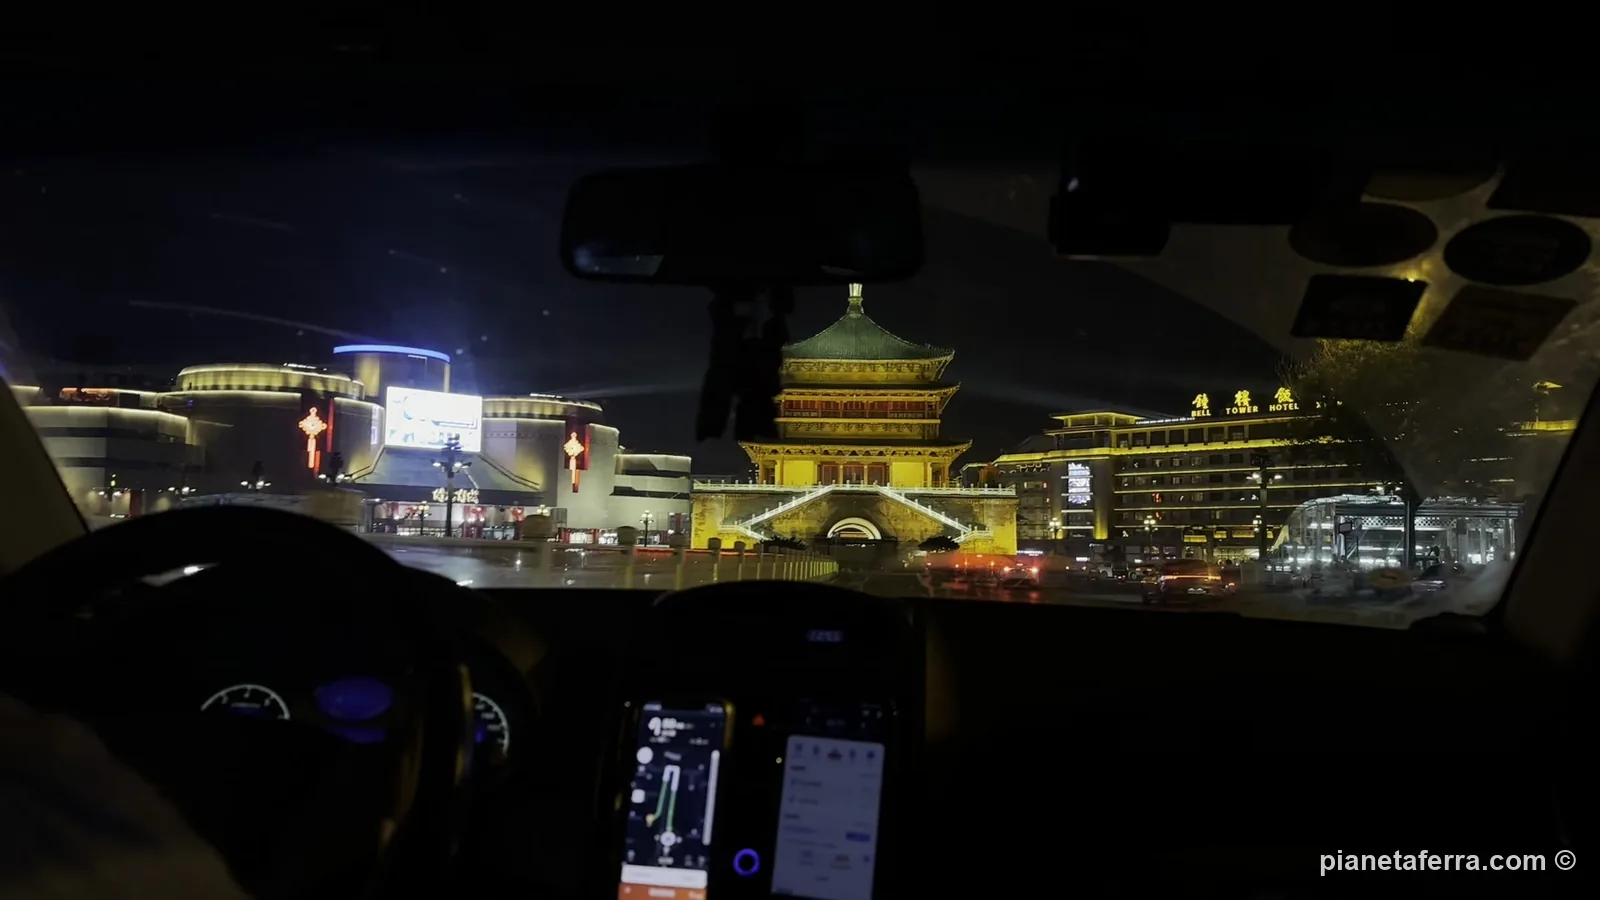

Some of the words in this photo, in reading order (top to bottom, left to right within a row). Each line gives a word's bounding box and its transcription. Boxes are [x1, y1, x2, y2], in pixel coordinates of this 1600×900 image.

[1191, 409, 1211, 417] BELL
[1226, 406, 1258, 415] TOWER
[1269, 403, 1299, 411] HOTEL
